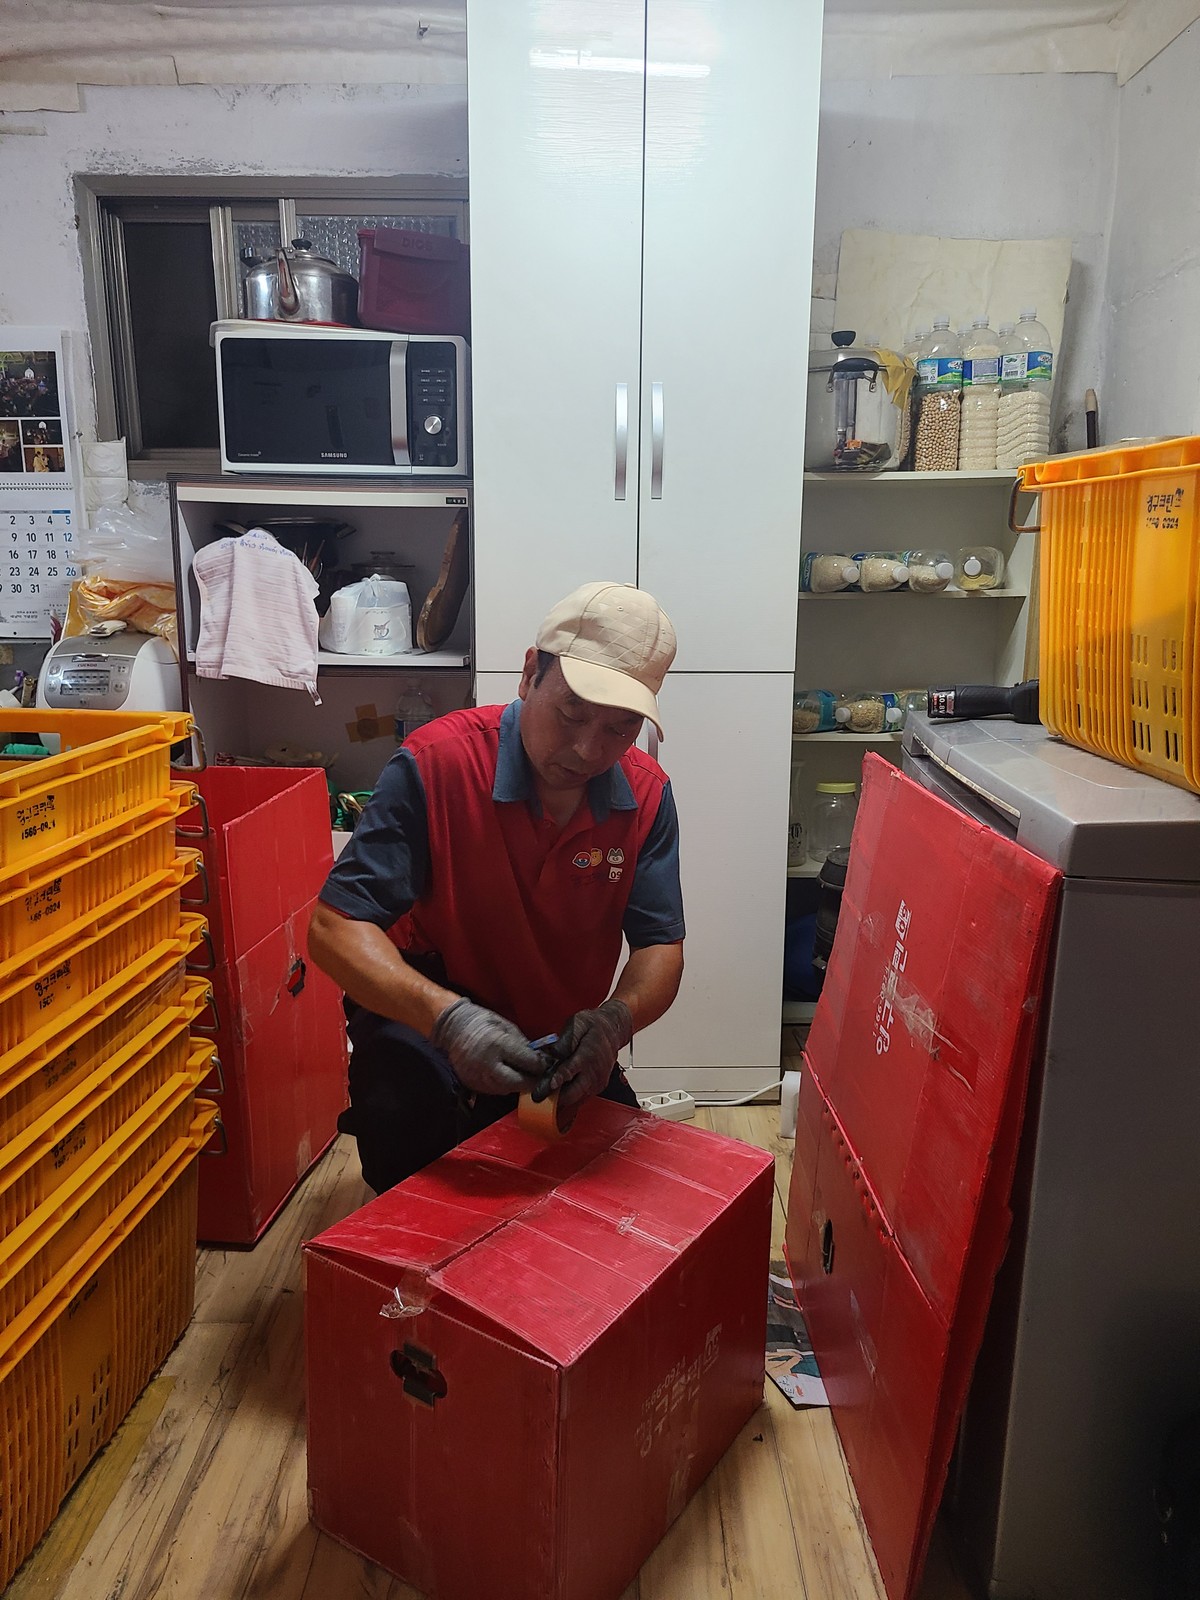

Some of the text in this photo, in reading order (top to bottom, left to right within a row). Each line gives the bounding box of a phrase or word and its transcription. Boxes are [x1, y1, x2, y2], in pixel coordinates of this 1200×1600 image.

[10, 515, 71, 525] 2 3 4 5
[11, 533, 72, 542] 9 10 11 12
[8, 550, 19, 560] 16
[27, 550, 37, 560] 17
[46, 550, 57, 560] 18
[9, 567, 76, 577] 23 24 25 26
[11, 584, 22, 594] 30
[30, 584, 40, 594] 31
[21, 819, 56, 840] 1566-09
